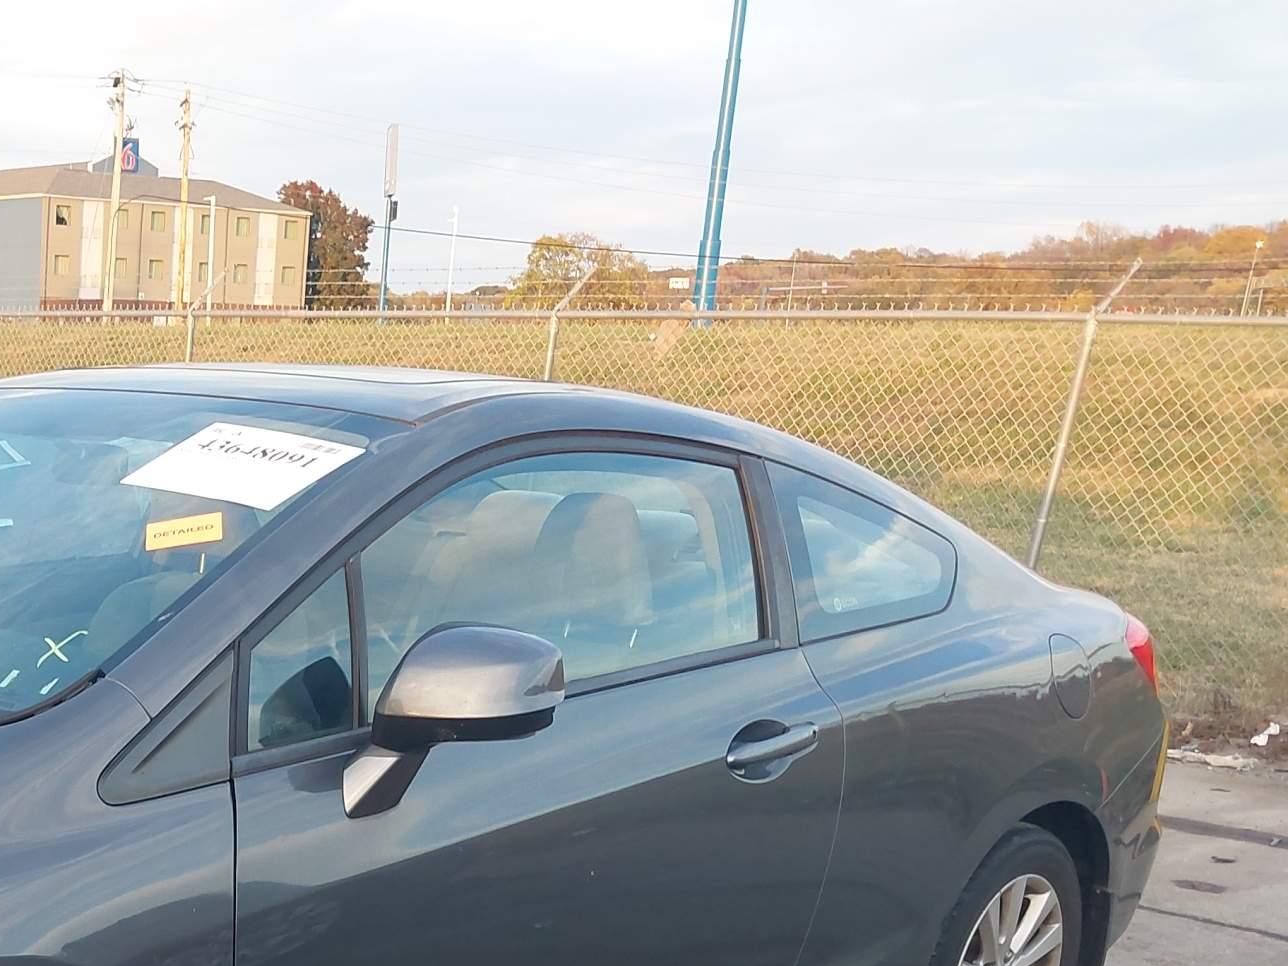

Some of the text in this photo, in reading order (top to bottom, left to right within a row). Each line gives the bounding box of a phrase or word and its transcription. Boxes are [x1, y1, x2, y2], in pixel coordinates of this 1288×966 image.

[121, 142, 136, 170] 6
[197, 438, 319, 468] 43648091
[153, 524, 214, 539] DETAILED
